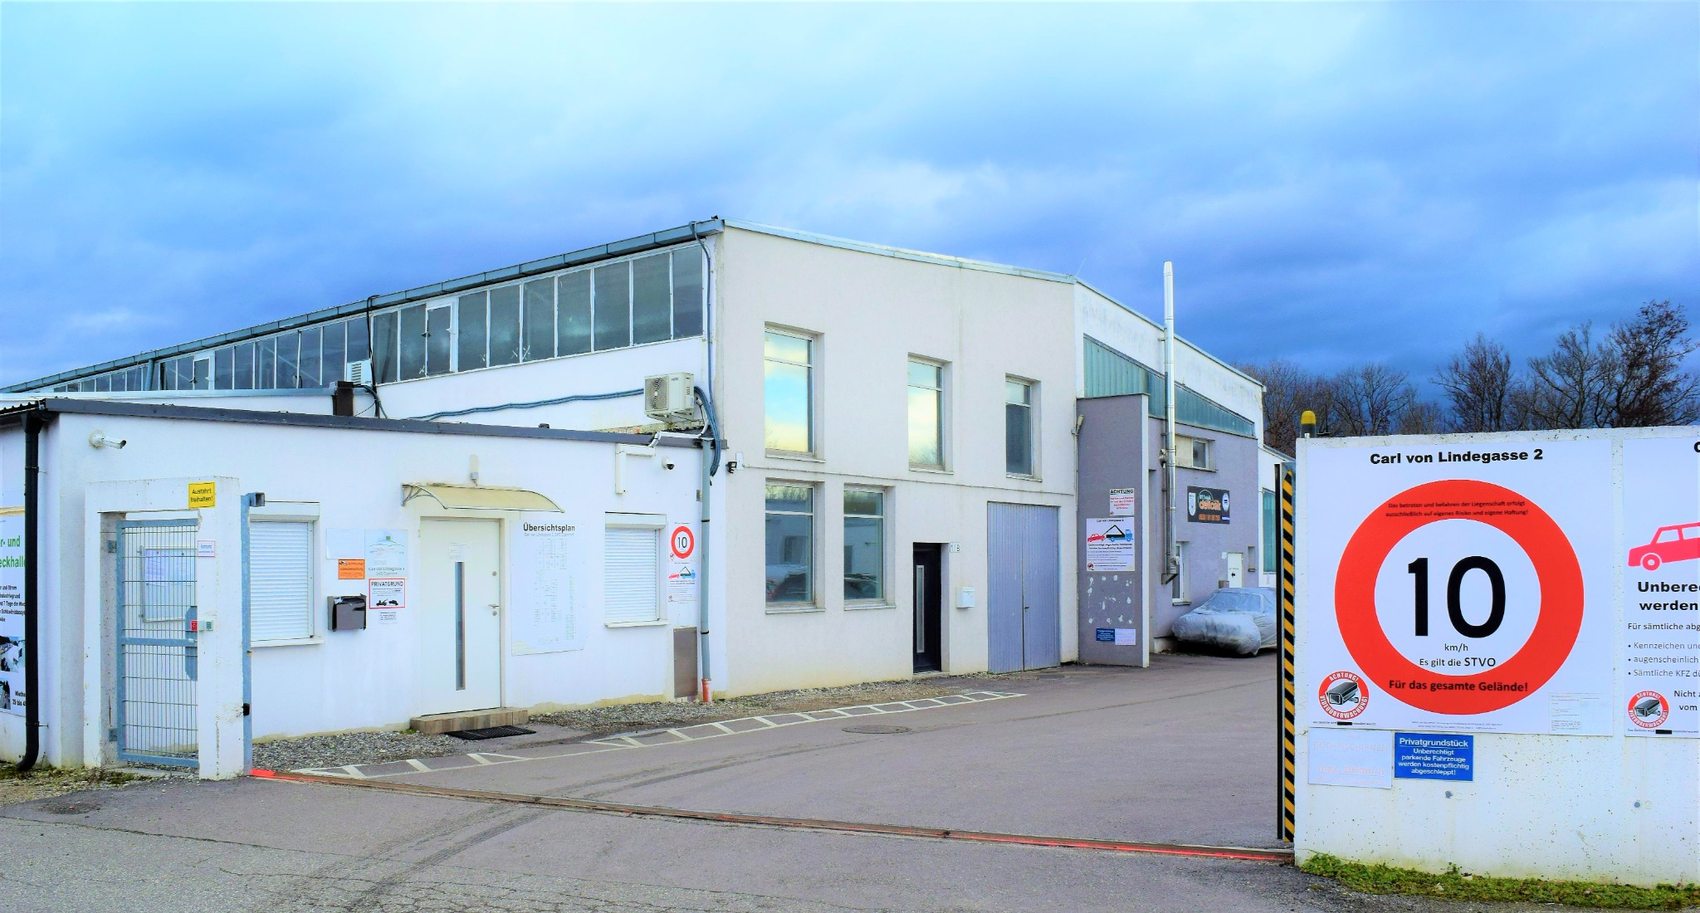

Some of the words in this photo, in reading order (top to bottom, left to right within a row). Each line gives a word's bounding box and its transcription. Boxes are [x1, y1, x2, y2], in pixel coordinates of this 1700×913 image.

[1370, 453, 1401, 464] Carl
[1406, 454, 1433, 463] von
[1438, 451, 1529, 464] Lindegasse
[1534, 449, 1543, 460] 2
[523, 521, 576, 533] Übersichtsplan
[8, 536, 20, 547] und
[678, 537, 687, 548] 10
[1638, 582, 1700, 592] Unbere
[1408, 556, 1506, 638] 10
[1639, 600, 1698, 610] werden
[1444, 643, 1469, 652] km/h
[1431, 659, 1445, 667] gilt
[1464, 657, 1496, 667] STVO
[1633, 656, 1699, 664] augenscheinlich
[1633, 669, 1673, 677] Sämtliche
[1389, 680, 1406, 688] Für
[1409, 680, 1427, 689] das
[1430, 681, 1476, 692] gesamte
[1478, 681, 1528, 692] Gelände!
[1399, 738, 1468, 747] Privatgrundstück
[1413, 748, 1454, 756] Unberechtigt
[1433, 755, 1466, 763] Fahrzeuge
[1423, 762, 1469, 770] kostenpflichtig
